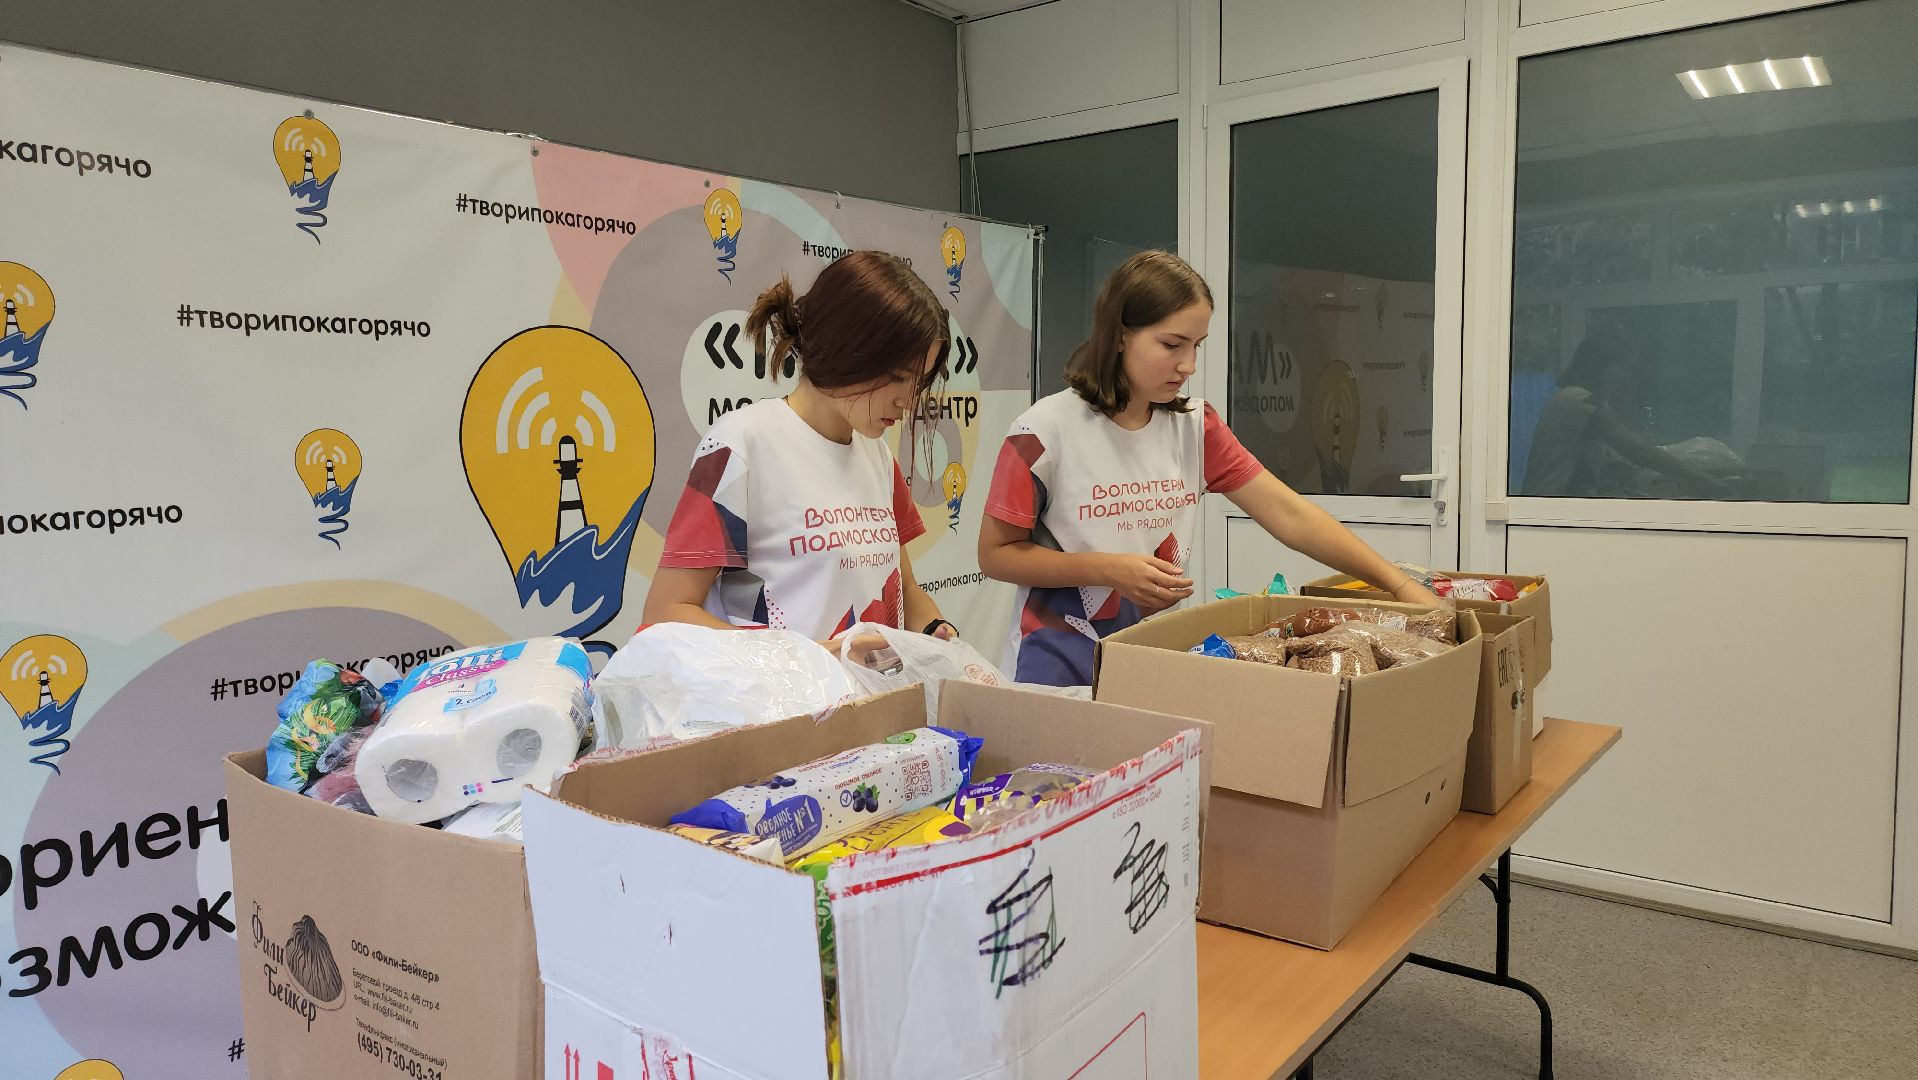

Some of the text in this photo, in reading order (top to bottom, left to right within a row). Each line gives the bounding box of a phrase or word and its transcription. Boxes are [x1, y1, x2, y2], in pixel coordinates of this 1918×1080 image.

[0, 139, 152, 179] кагорячо
[456, 192, 637, 236] #творипокагорячо
[176, 303, 432, 342] #творипокагорячо
[1137, 516, 1173, 530] РЯДОМ
[840, 552, 894, 571] МЫ РЯДОМ
[0, 888, 236, 998] змож
[351, 939, 370, 957] ООО
[263, 962, 317, 1033] Бейкер
[357, 1031, 384, 1064] (495)
